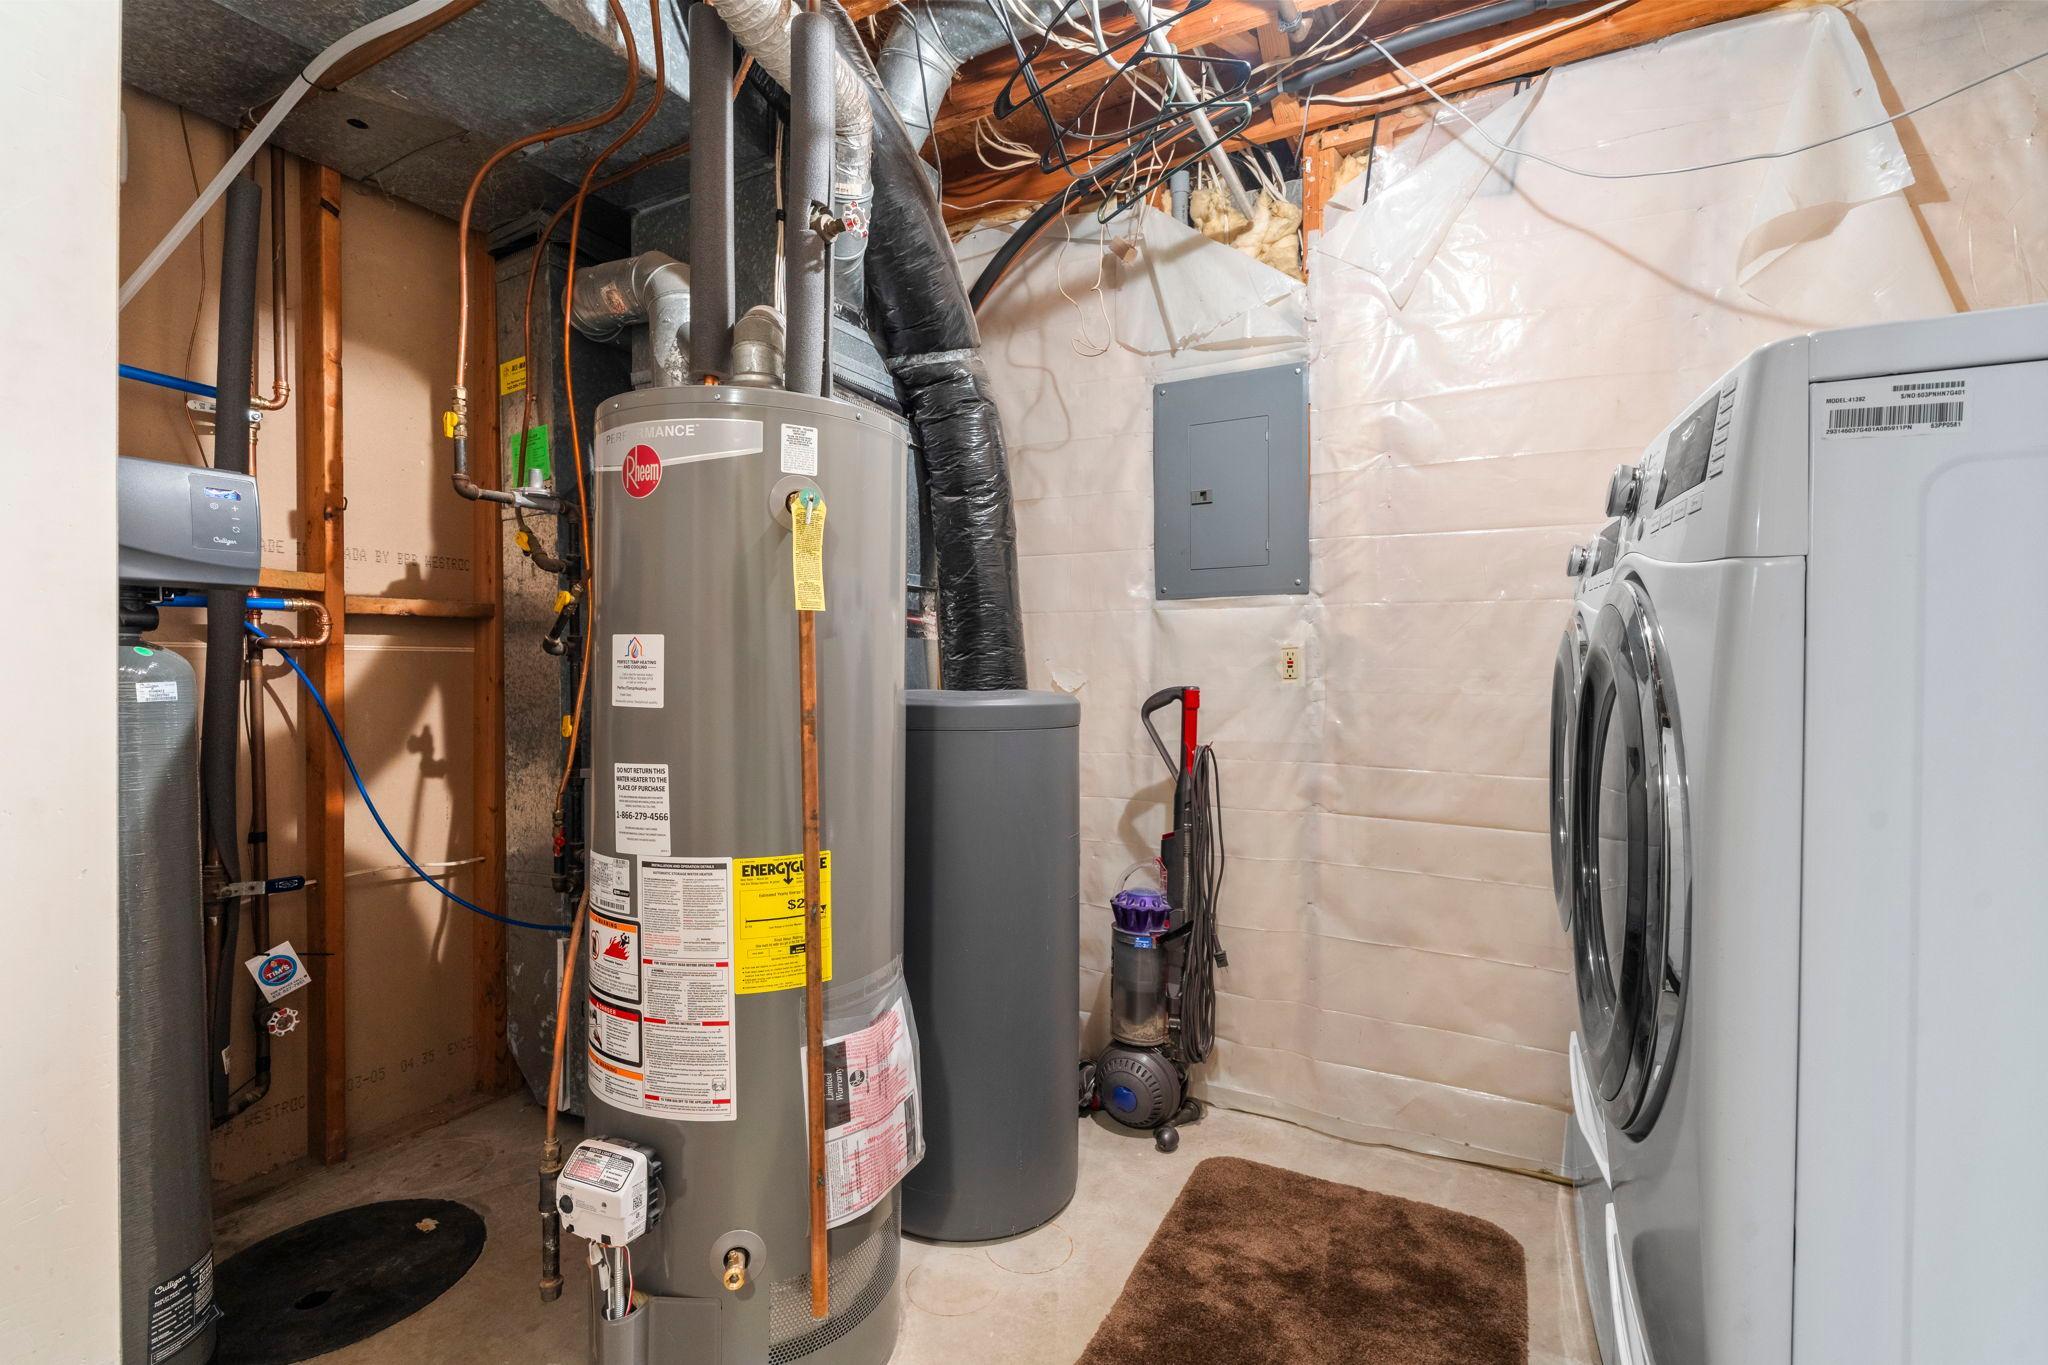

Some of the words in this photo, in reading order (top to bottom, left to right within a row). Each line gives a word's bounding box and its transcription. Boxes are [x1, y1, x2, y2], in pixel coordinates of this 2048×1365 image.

[606, 424, 695, 444] PERFRMANCE
[626, 446, 659, 489] Rheem
[213, 536, 237, 546] Culligan
[260, 538, 285, 554] ADE
[633, 767, 653, 775] RETURN
[616, 810, 669, 821] 1-866-279-4566
[824, 1073, 834, 1101] Limited
[836, 1067, 845, 1101] Warranty
[154, 1275, 187, 1295] Culligan
